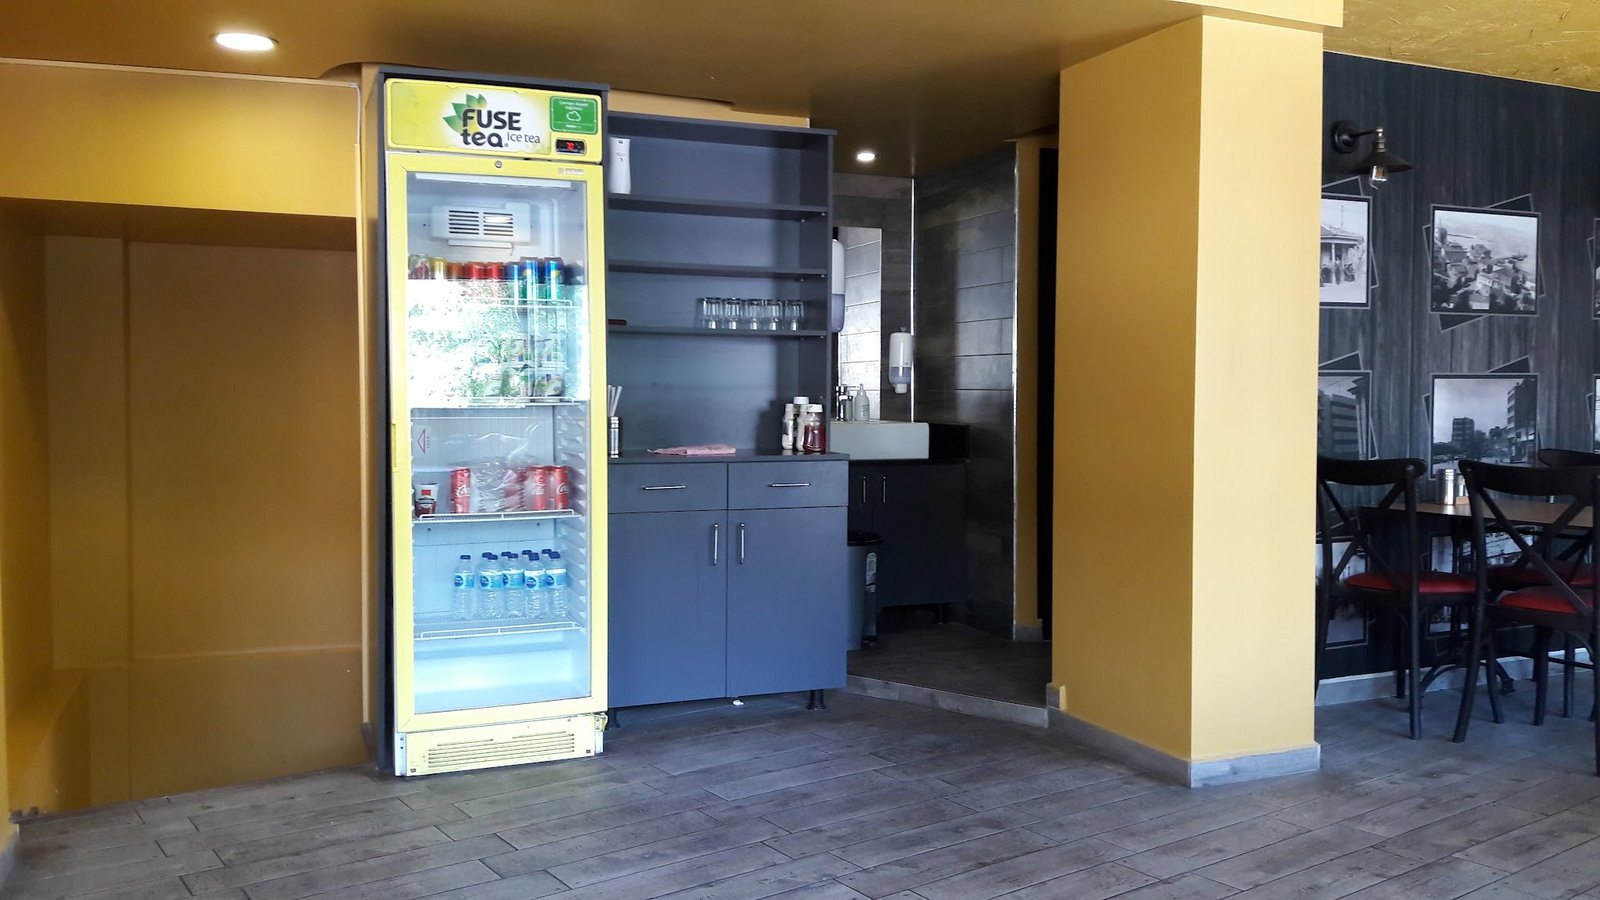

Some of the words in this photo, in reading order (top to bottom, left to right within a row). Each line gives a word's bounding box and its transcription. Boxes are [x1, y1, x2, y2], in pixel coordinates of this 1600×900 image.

[462, 108, 522, 131] FUSE
[460, 128, 504, 148] tea
[524, 134, 541, 144] tea
